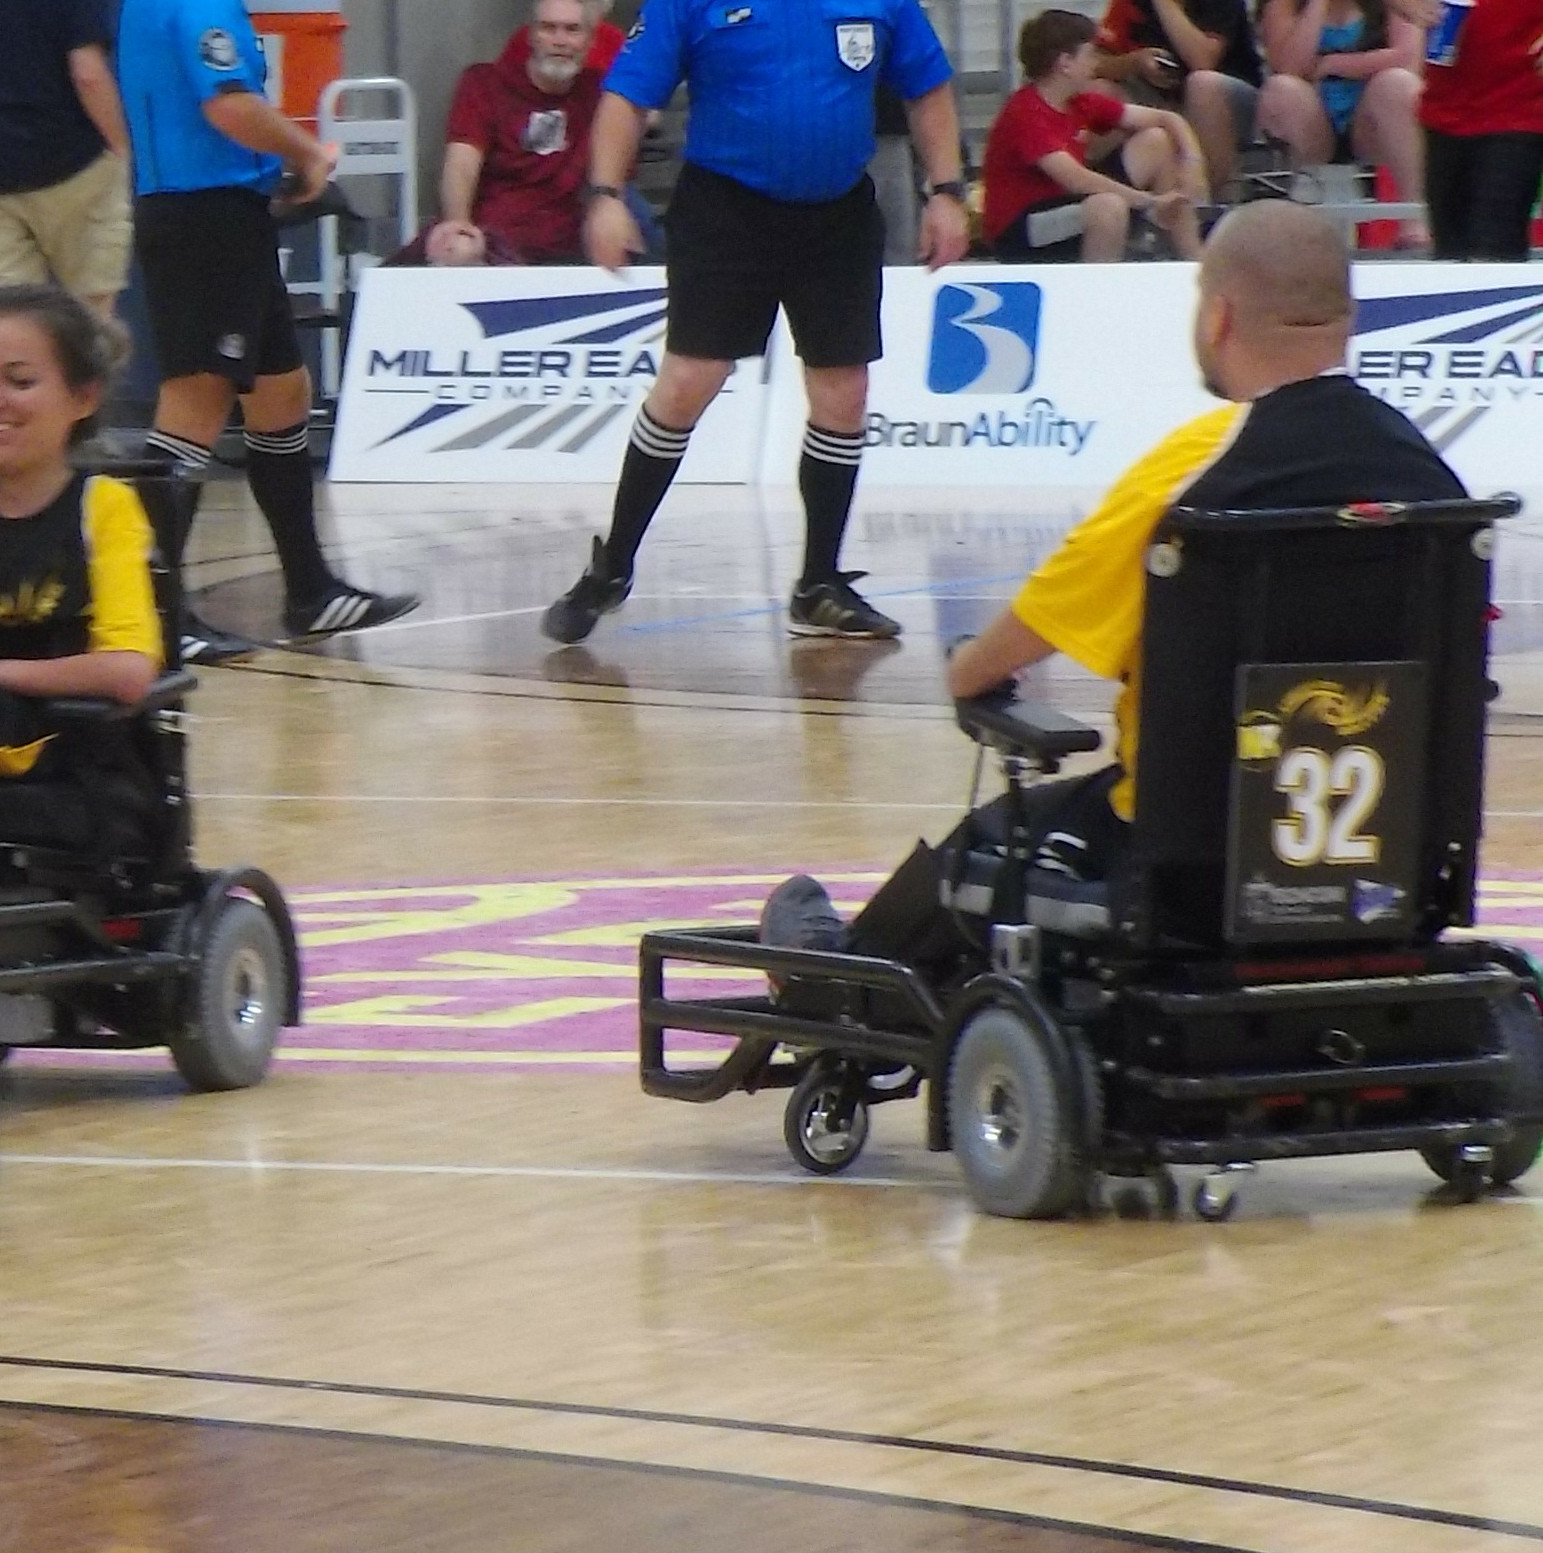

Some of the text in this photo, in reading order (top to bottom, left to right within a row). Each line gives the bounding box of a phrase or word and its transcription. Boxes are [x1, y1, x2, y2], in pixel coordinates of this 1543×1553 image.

[367, 349, 658, 378] MILLER EA
[864, 397, 1097, 456] BraunAbility
[1273, 745, 1386, 868] 32
